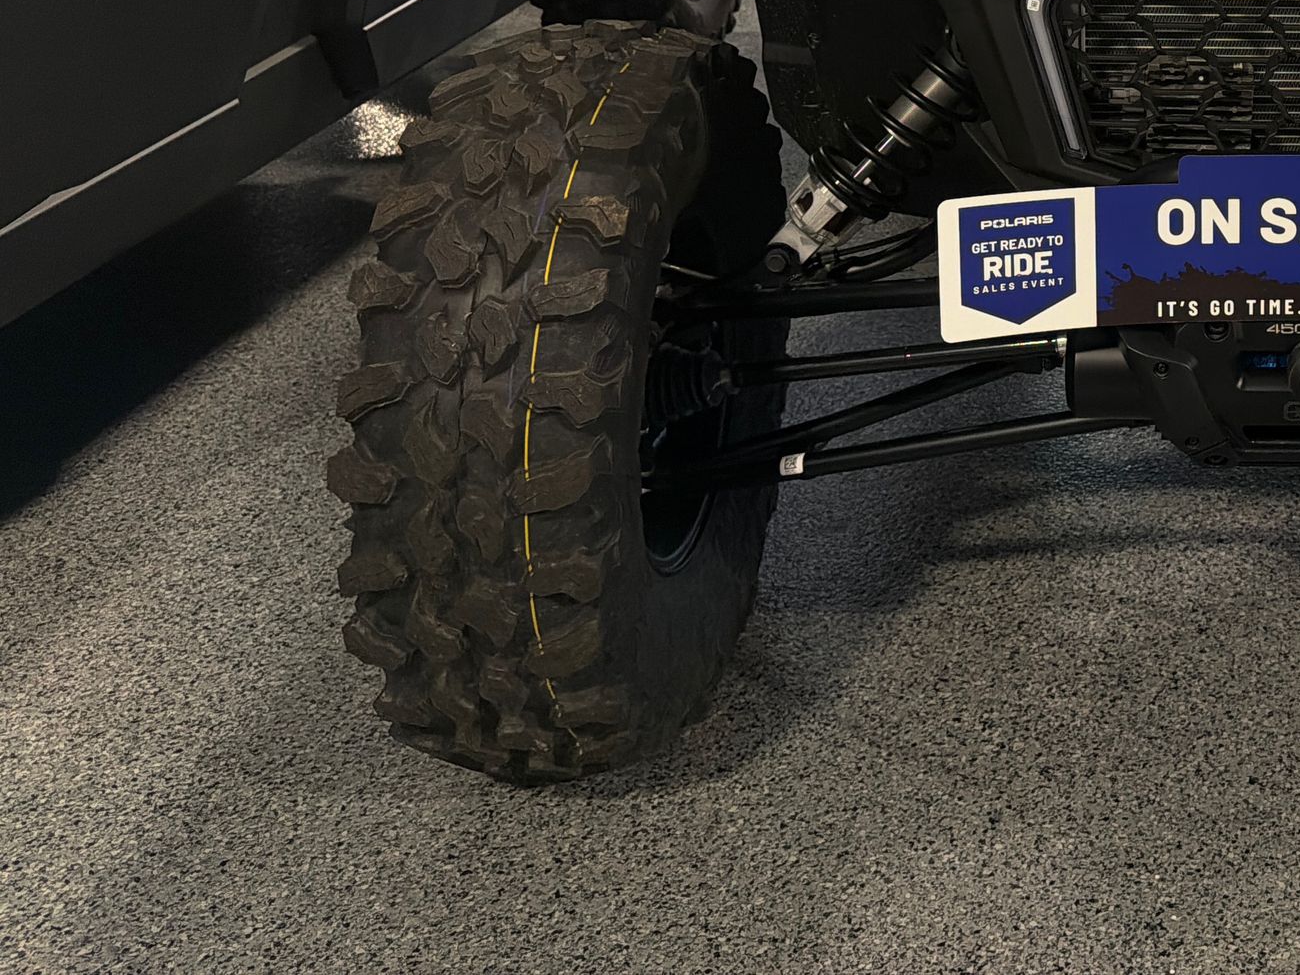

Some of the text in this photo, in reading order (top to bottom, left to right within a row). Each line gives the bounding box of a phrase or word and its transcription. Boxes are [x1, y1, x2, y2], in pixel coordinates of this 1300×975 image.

[980, 214, 1054, 230] POLARIS
[1157, 198, 1241, 246] ON
[971, 235, 1064, 254] GET READY TO
[983, 251, 1053, 281] RIDE
[973, 277, 1064, 295] SALES EVENT
[1157, 301, 1199, 317] IT'S
[1209, 299, 1235, 317] GO
